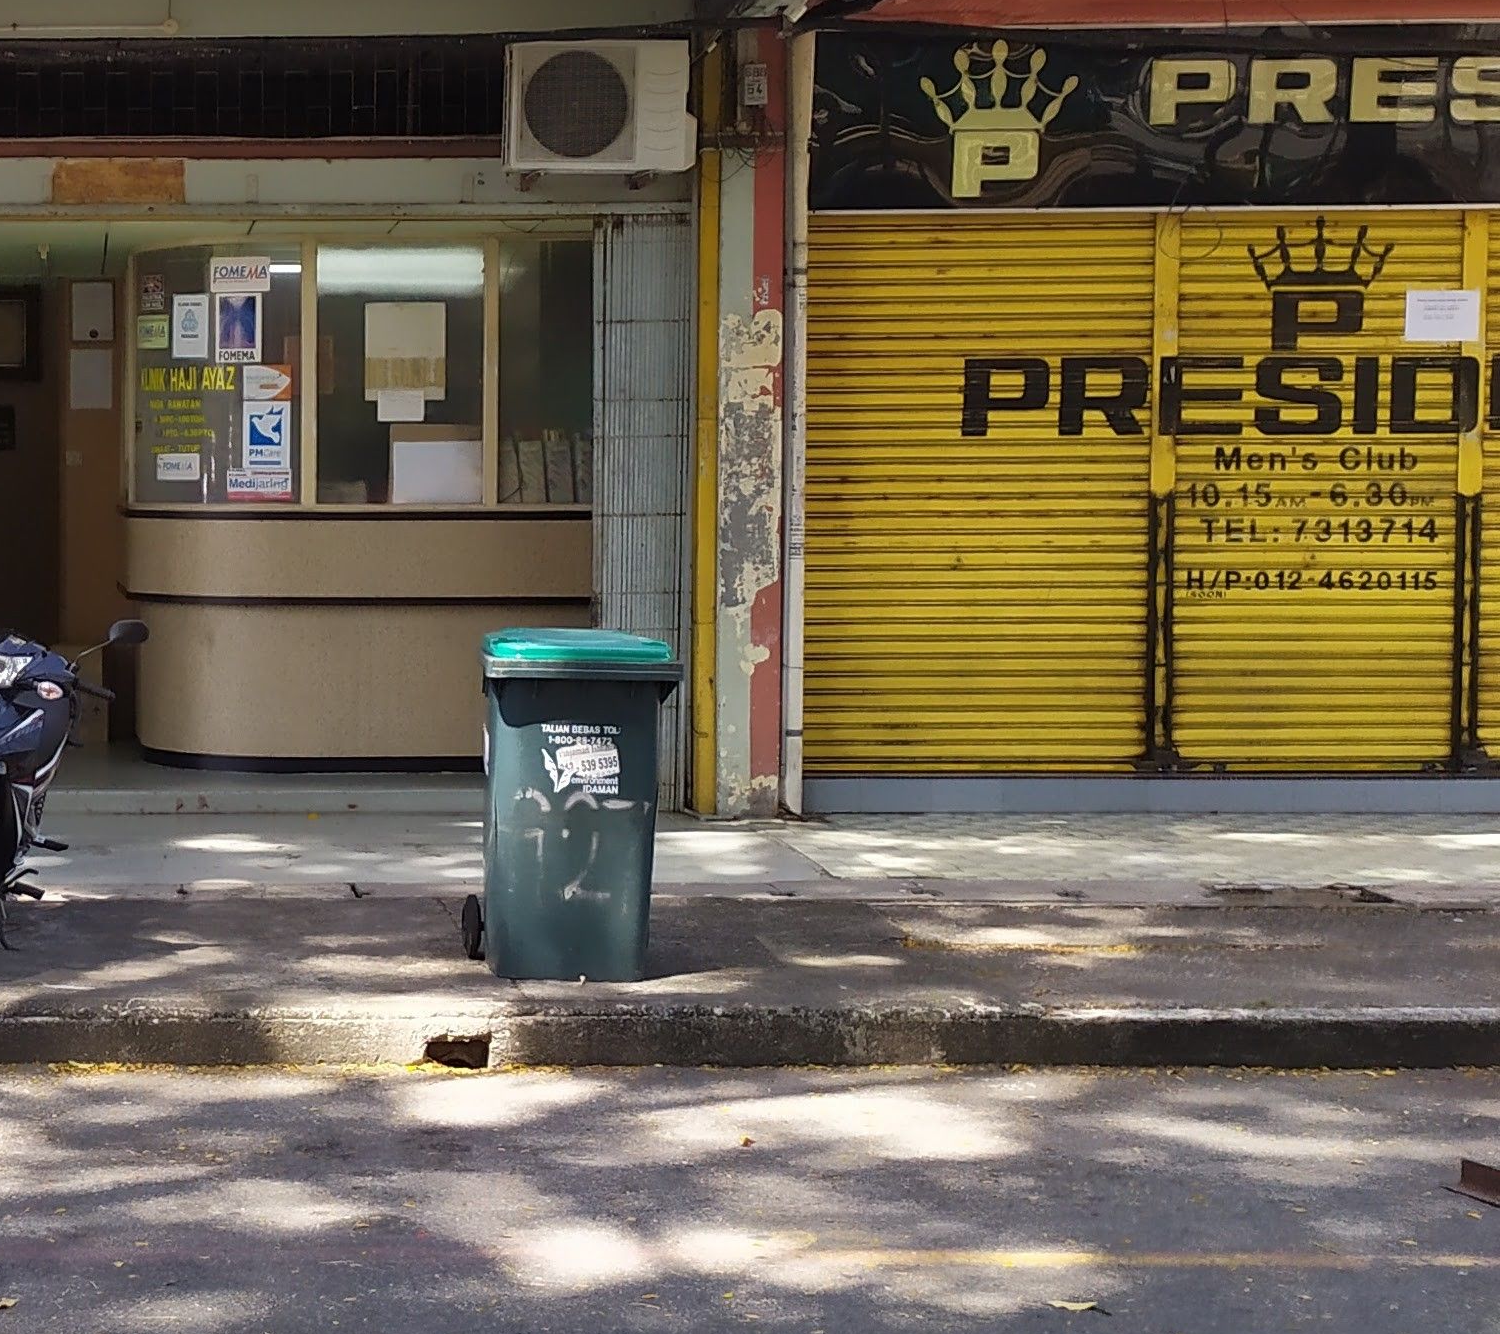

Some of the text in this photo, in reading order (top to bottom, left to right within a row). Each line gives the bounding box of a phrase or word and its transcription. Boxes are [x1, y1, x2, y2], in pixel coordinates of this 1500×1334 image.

[213, 265, 268, 284] FOMEMA
[218, 350, 255, 361] FOMEMA
[170, 366, 197, 392] HAJI
[202, 365, 235, 390] AYAZ
[961, 356, 1500, 437] PRESID
[1214, 446, 1418, 471] Men's Club
[1291, 517, 1439, 543] 7313714
[541, 723, 570, 734] TALIAN
[572, 725, 601, 734] BEBAS
[571, 776, 619, 785] environment
[582, 785, 619, 794] IDAMAN
